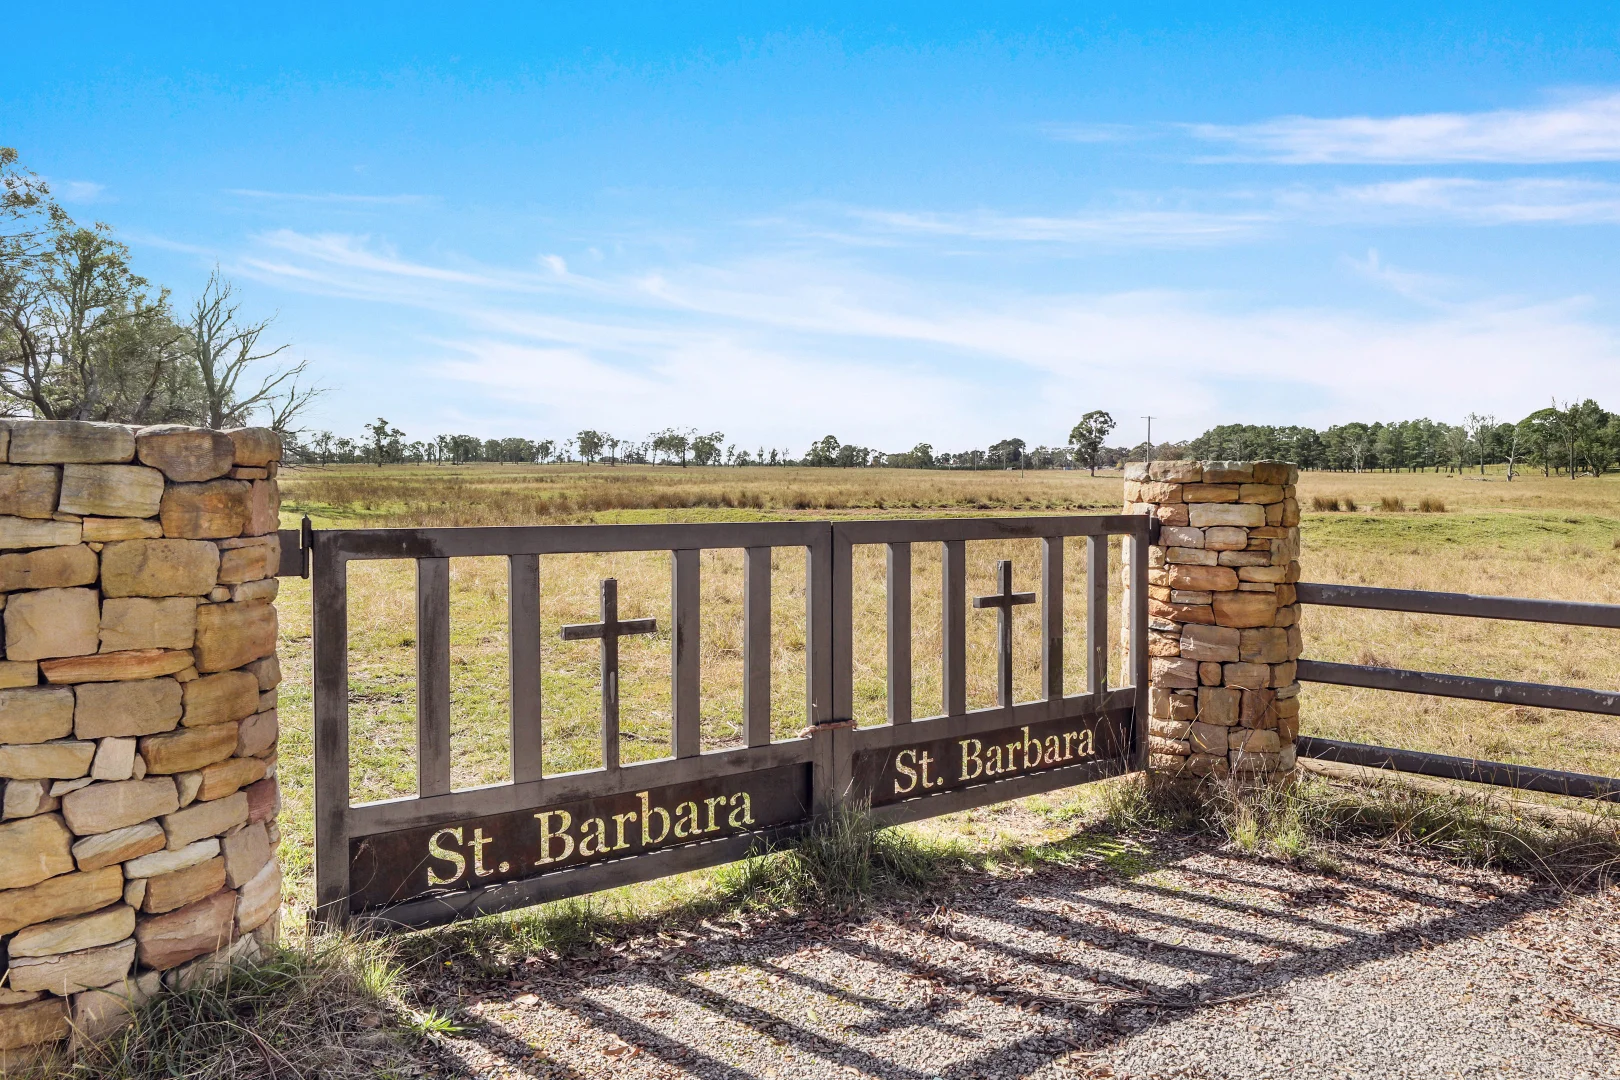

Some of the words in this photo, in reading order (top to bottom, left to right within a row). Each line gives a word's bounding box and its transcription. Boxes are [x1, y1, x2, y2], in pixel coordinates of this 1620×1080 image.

[894, 749, 944, 794] St.
[958, 726, 1096, 781] Barbara
[427, 826, 510, 887] St.
[534, 791, 755, 866] Barbara
